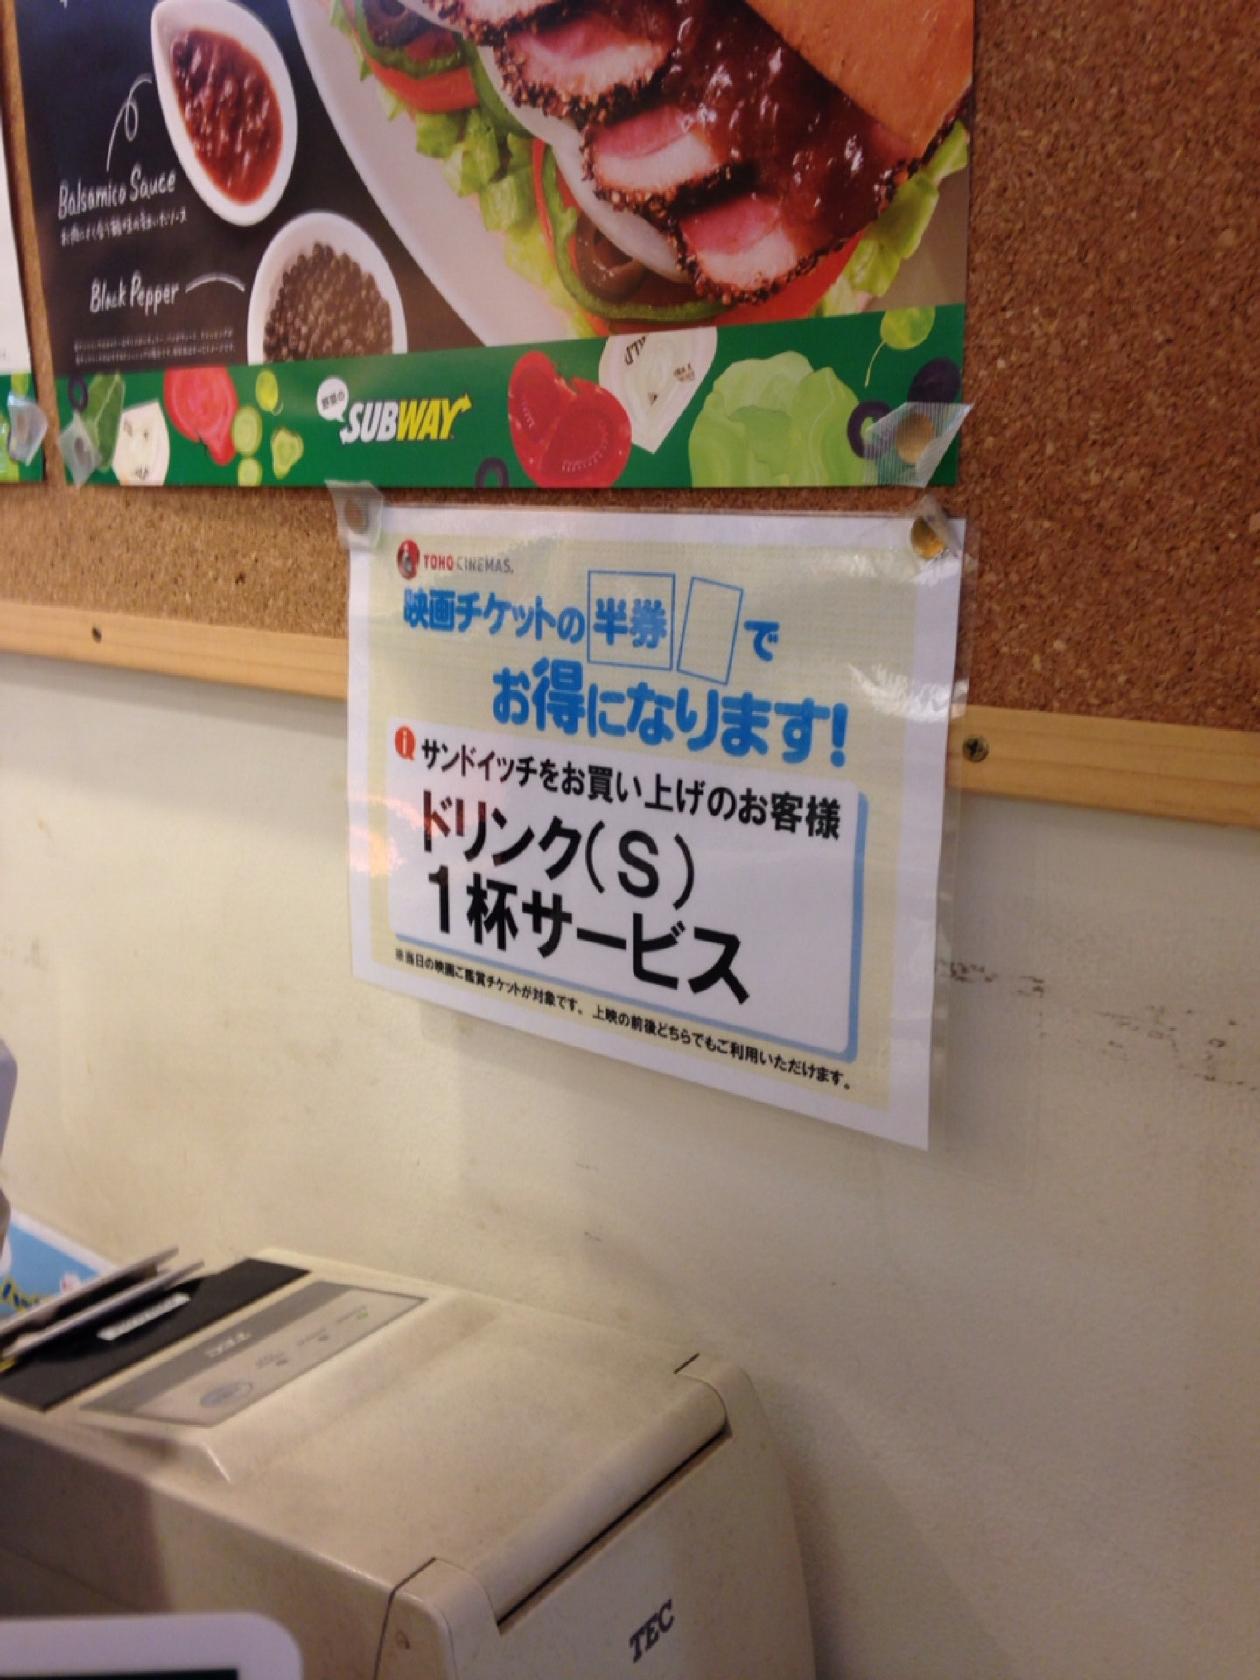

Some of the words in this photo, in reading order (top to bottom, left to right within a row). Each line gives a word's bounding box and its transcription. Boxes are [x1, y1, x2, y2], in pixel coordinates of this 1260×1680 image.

[129, 161, 177, 202] Sauce
[90, 278, 126, 313] Black
[129, 269, 180, 317] Pepper
[339, 393, 472, 445] SUBWAY
[424, 554, 453, 571] TOHO
[743, 619, 780, 662] で
[492, 657, 848, 768] お得になります!
[421, 738, 841, 840] サンドイッチをお買い上げのお客様
[428, 865, 750, 1005] 1杯サービス
[629, 1599, 675, 1664] TEC
